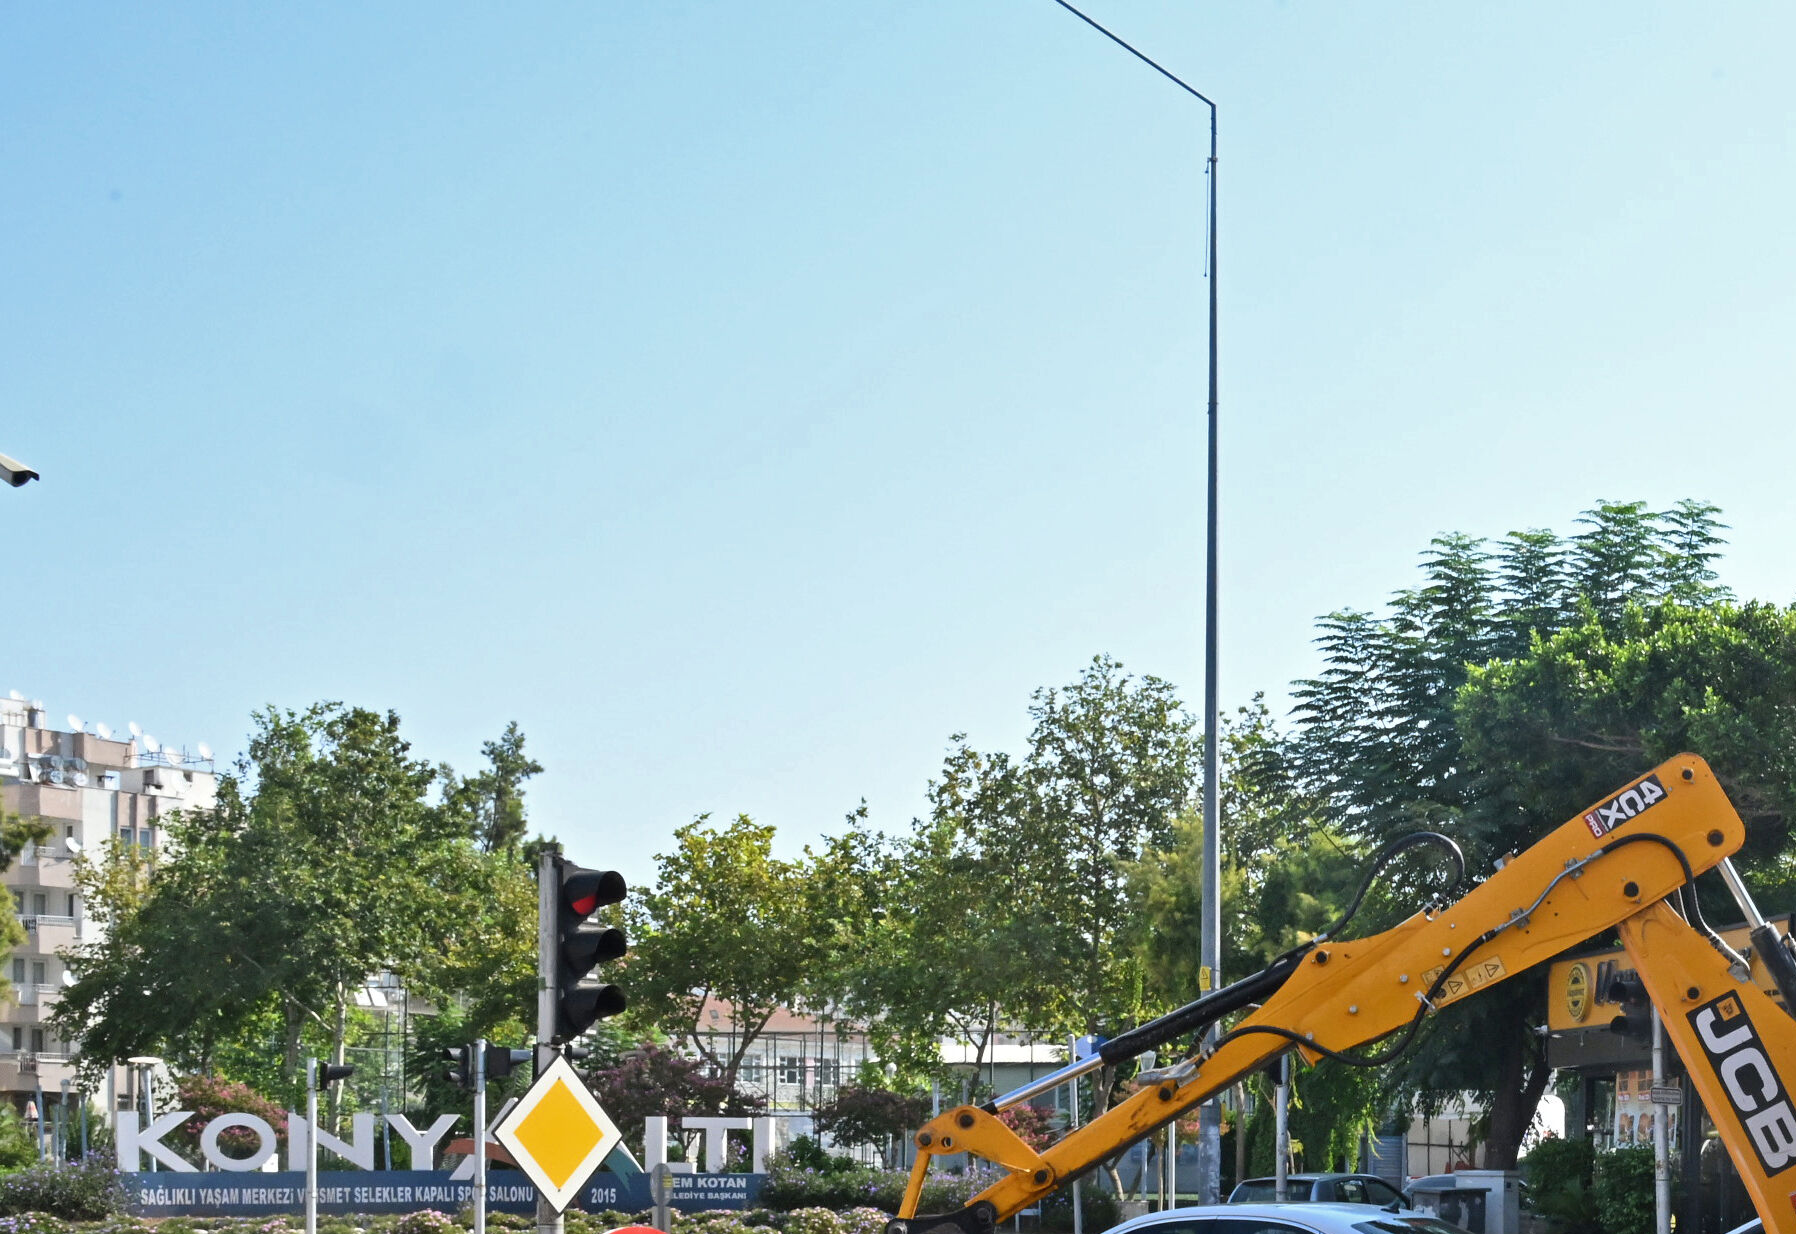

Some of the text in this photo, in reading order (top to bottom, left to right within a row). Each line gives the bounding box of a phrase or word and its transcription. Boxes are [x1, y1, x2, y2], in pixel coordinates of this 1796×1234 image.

[1599, 781, 1663, 829] 4CX
[1585, 814, 1603, 838] PRO
[672, 1177, 747, 1189] EM KOTAN
[141, 1185, 196, 1206] SAĞLIKLI
[199, 1187, 239, 1208] YAŞAM
[354, 1186, 412, 1203] SELEKLER
[415, 1186, 454, 1202] KAPALI
[490, 1186, 534, 1203] SALONU
[591, 1188, 617, 1204] 2015
